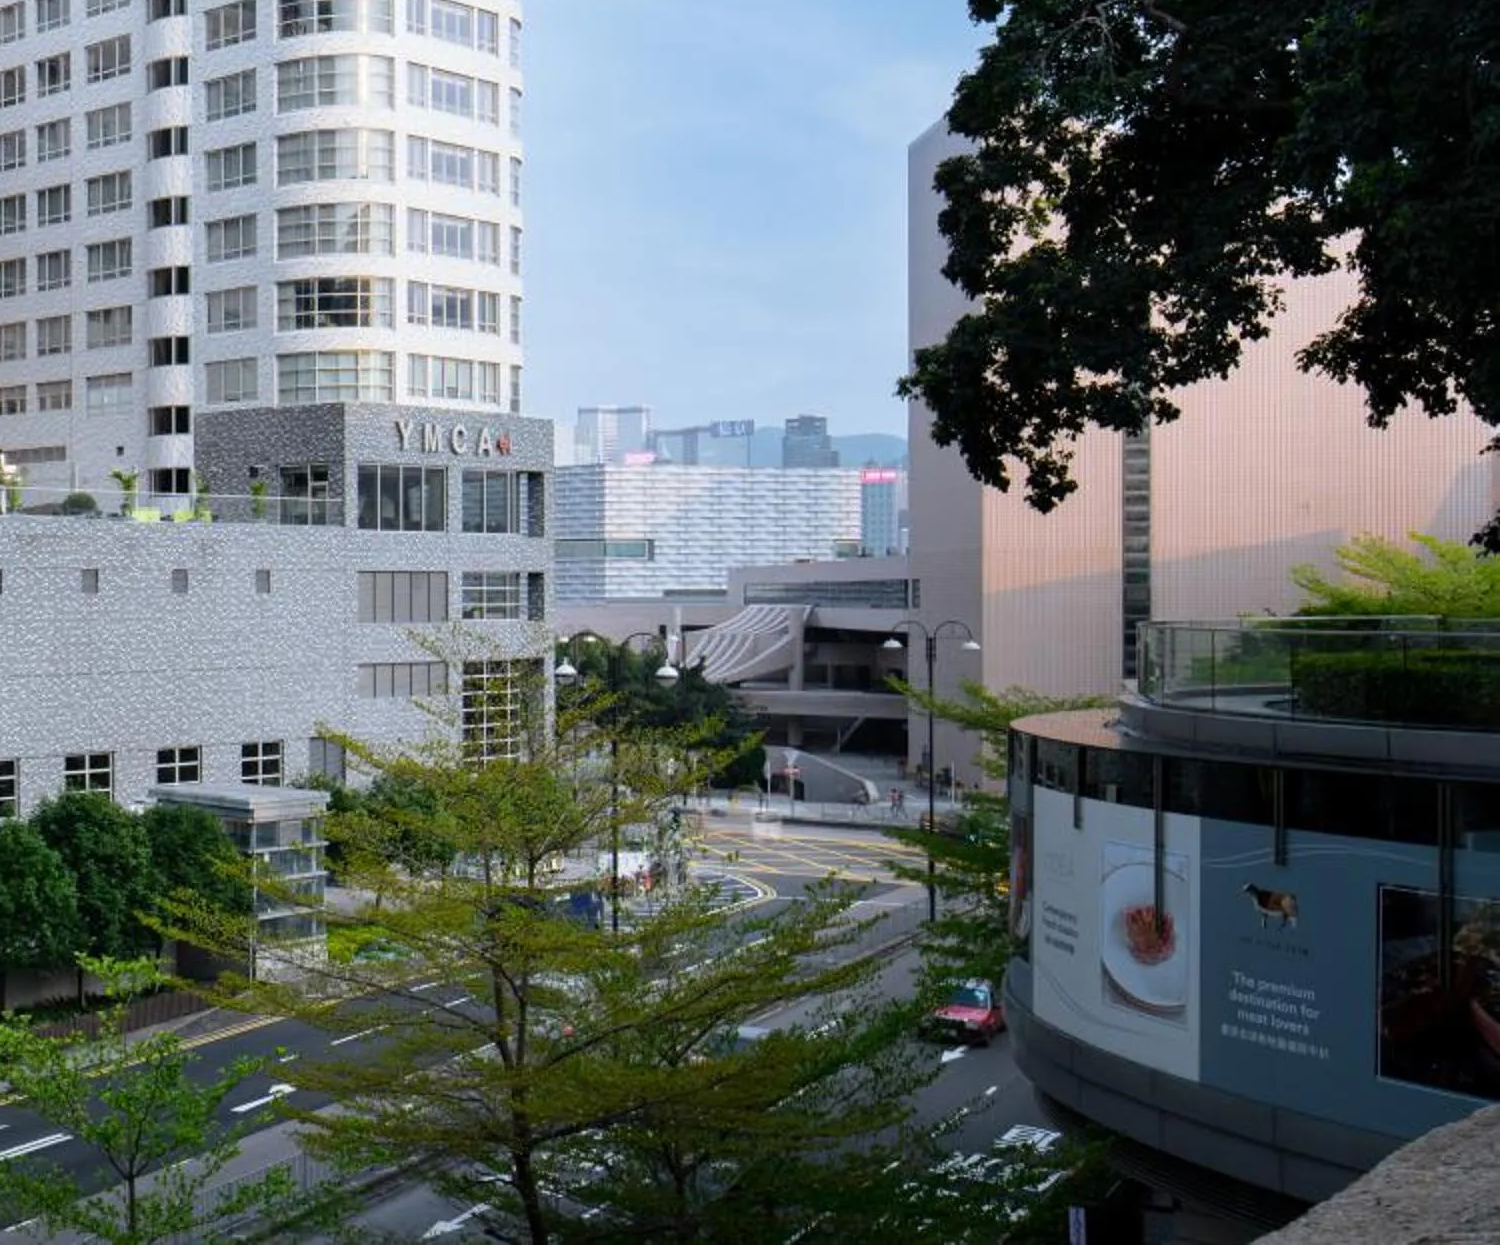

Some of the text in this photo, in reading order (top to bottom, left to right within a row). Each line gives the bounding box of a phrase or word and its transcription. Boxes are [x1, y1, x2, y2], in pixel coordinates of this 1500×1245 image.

[395, 419, 492, 457] YMCA
[1231, 970, 1316, 1001] The premium
[1229, 988, 1320, 1020] destination for
[1238, 1009, 1310, 1036] meat lovers
